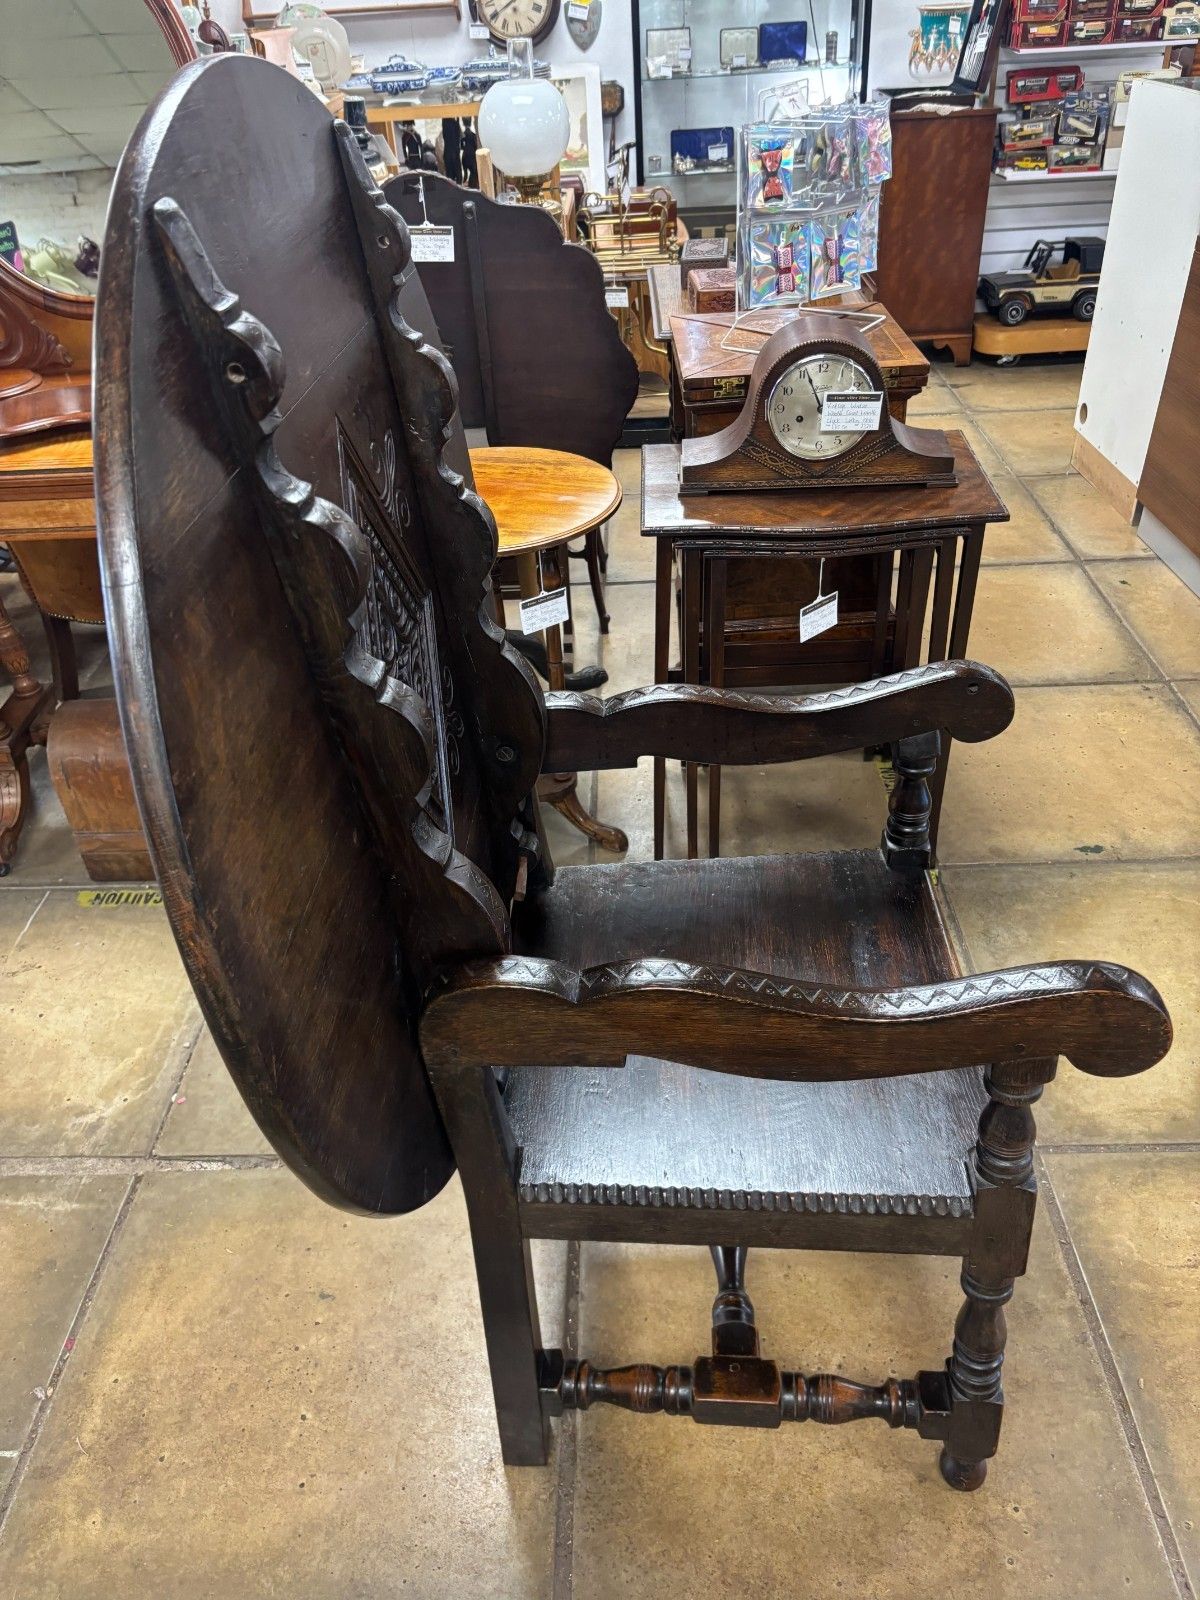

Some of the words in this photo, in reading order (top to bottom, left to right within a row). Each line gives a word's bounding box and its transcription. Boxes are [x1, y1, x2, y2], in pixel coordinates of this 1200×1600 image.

[818, 363, 829, 374] 12
[783, 386, 793, 396] 10
[815, 441, 823, 452] 6
